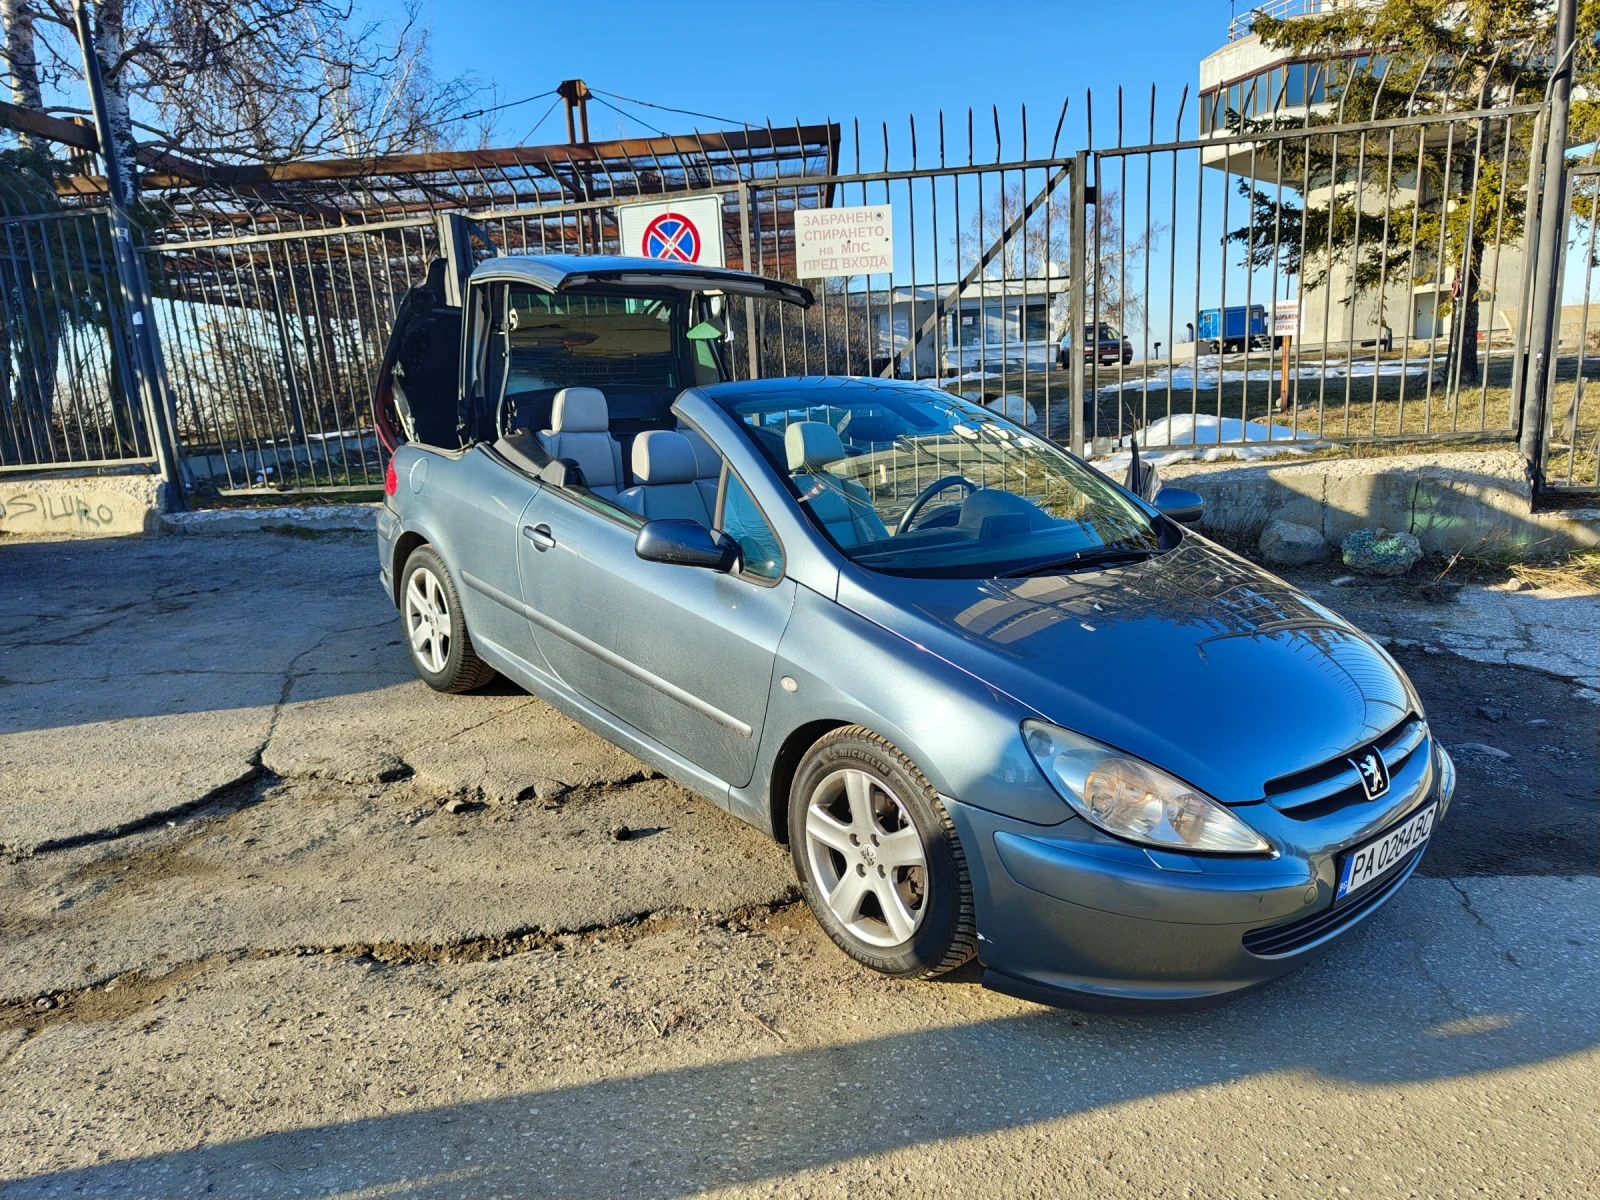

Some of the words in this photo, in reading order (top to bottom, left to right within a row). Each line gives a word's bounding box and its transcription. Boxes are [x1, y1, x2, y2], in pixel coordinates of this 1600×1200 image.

[804, 226, 884, 241] СПИРАНЕТО
[819, 247, 834, 255] на
[841, 242, 870, 254] МПС
[803, 259, 838, 272] ПРЕД
[842, 256, 888, 269] ВХОДА
[839, 748, 890, 775] MICHELIN
[1350, 848, 1375, 887] PA
[1377, 821, 1415, 870] 0284
[1412, 808, 1434, 844] BC
